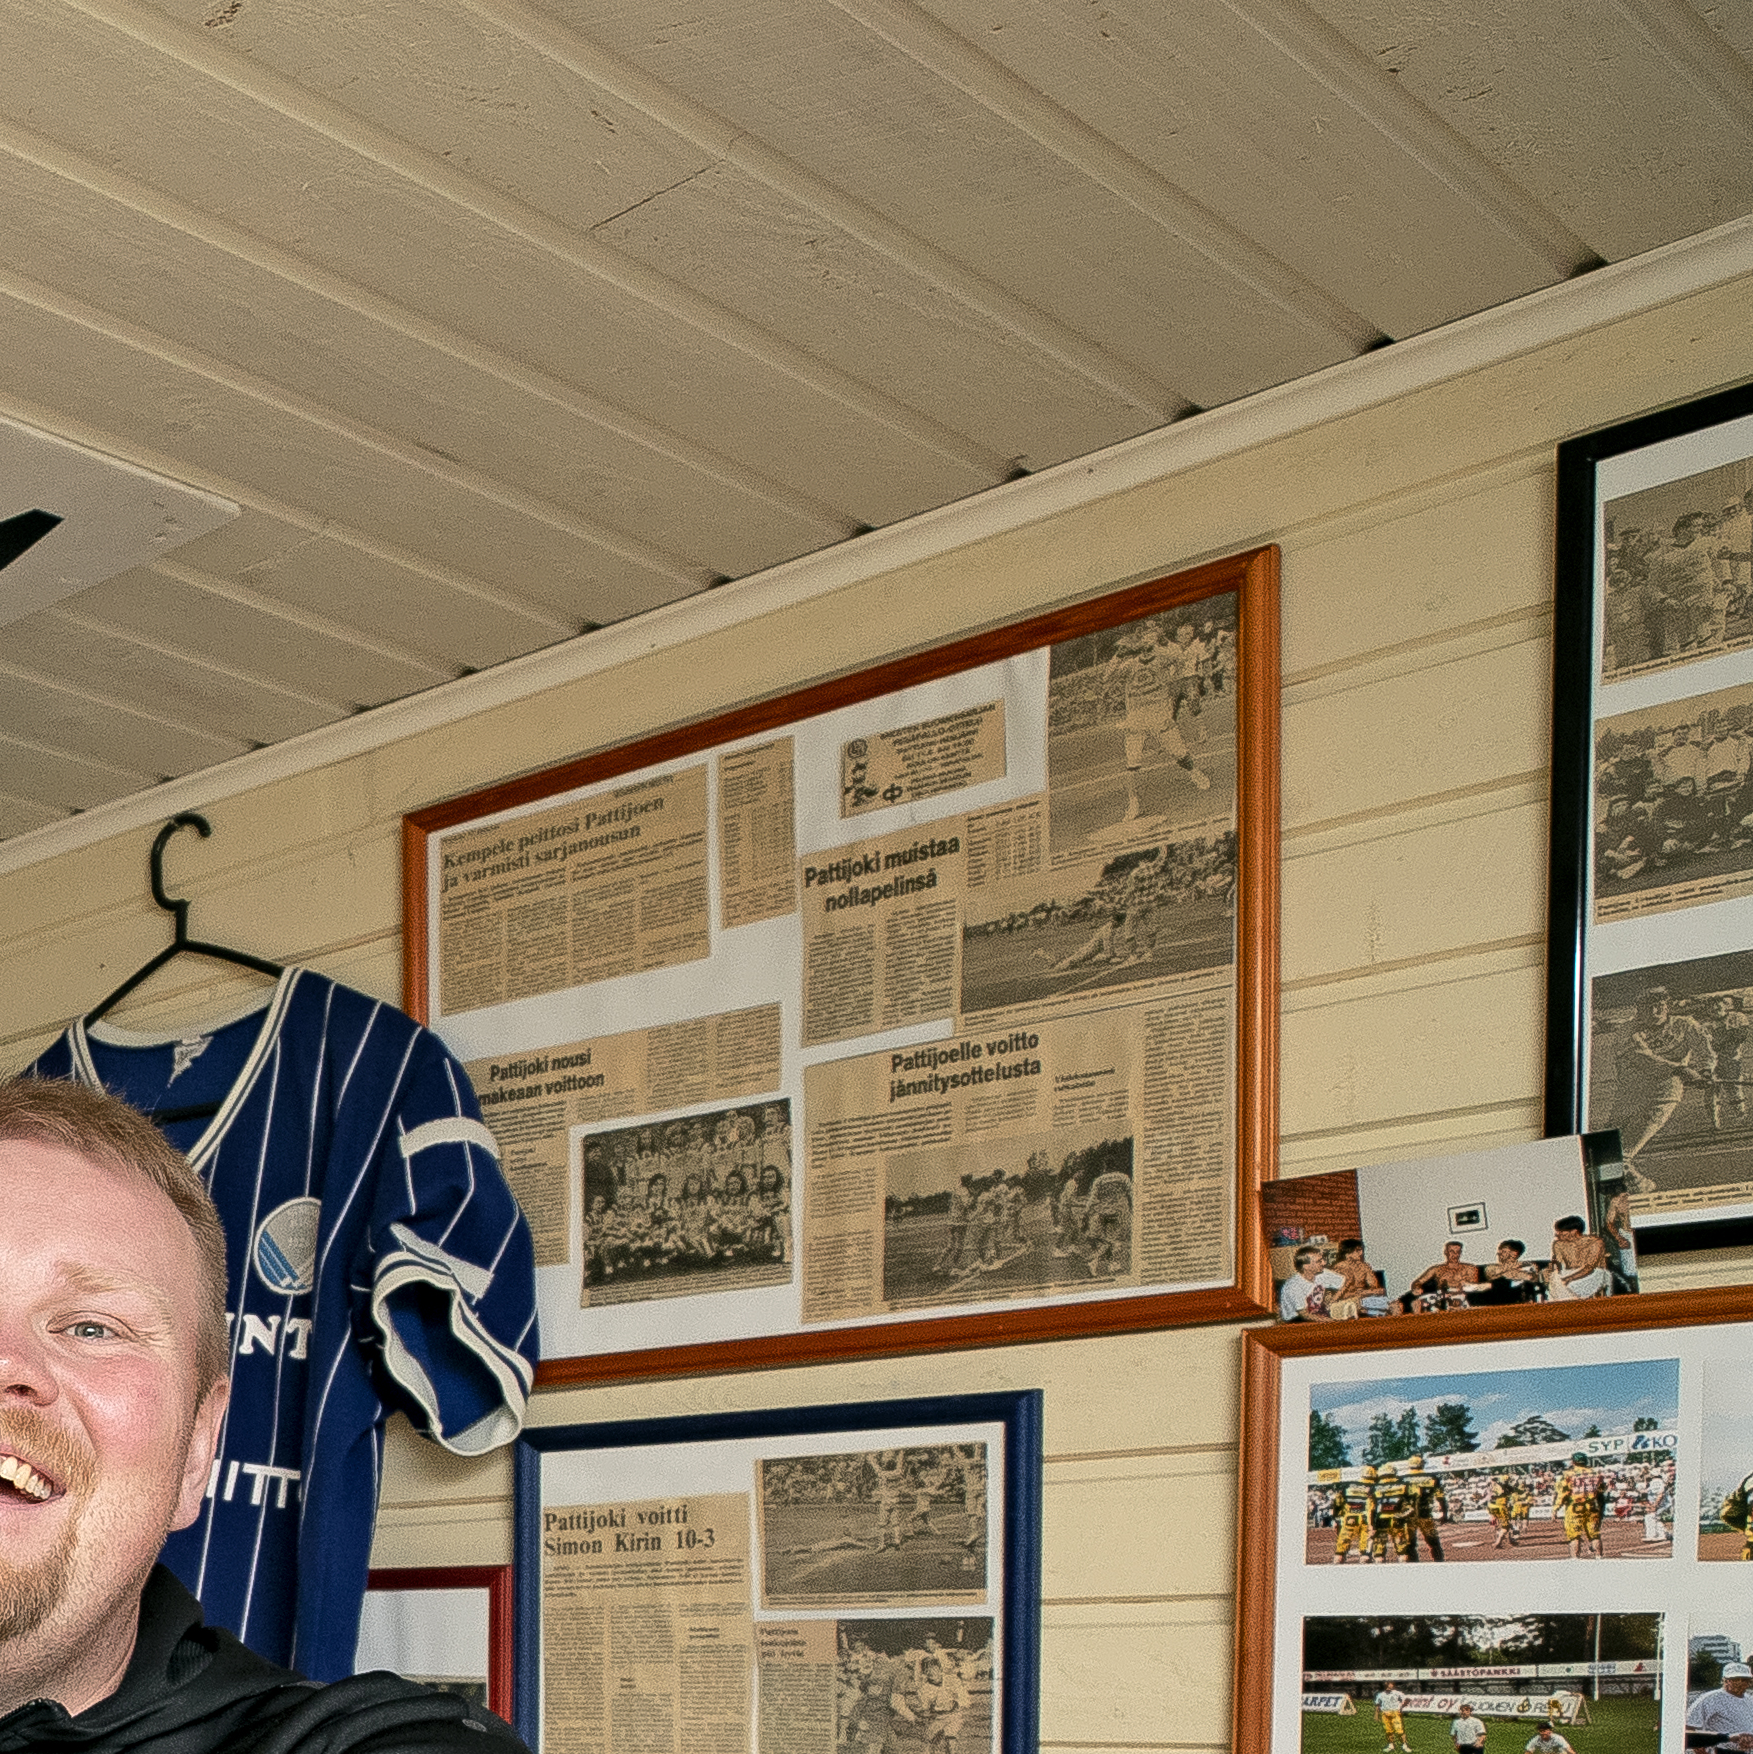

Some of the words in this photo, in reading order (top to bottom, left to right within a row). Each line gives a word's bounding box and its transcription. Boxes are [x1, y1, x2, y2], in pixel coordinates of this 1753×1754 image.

[444, 839, 515, 869] Kempele
[518, 818, 580, 851] peittosi
[585, 798, 665, 831] Pattijoen
[462, 854, 530, 884] varmisti
[534, 825, 641, 862] sarjanousun
[804, 851, 881, 888] Pattijoki
[884, 836, 960, 870] muistaa
[825, 868, 937, 912] nollapelinsä
[490, 1055, 549, 1082] Pattijoki
[552, 1048, 591, 1070] nousi
[891, 1041, 982, 1073] Pattijoelle
[986, 1031, 1039, 1057] voitto
[478, 1082, 542, 1107] makeaan
[545, 1072, 604, 1096] voittoon
[890, 1058, 1042, 1103] jännitysottelusta
[545, 1508, 626, 1533] Pattijoki
[637, 1505, 688, 1526] voitti
[544, 1537, 603, 1556] Simon
[615, 1532, 662, 1552] Kirin
[676, 1528, 715, 1550] 10-3
